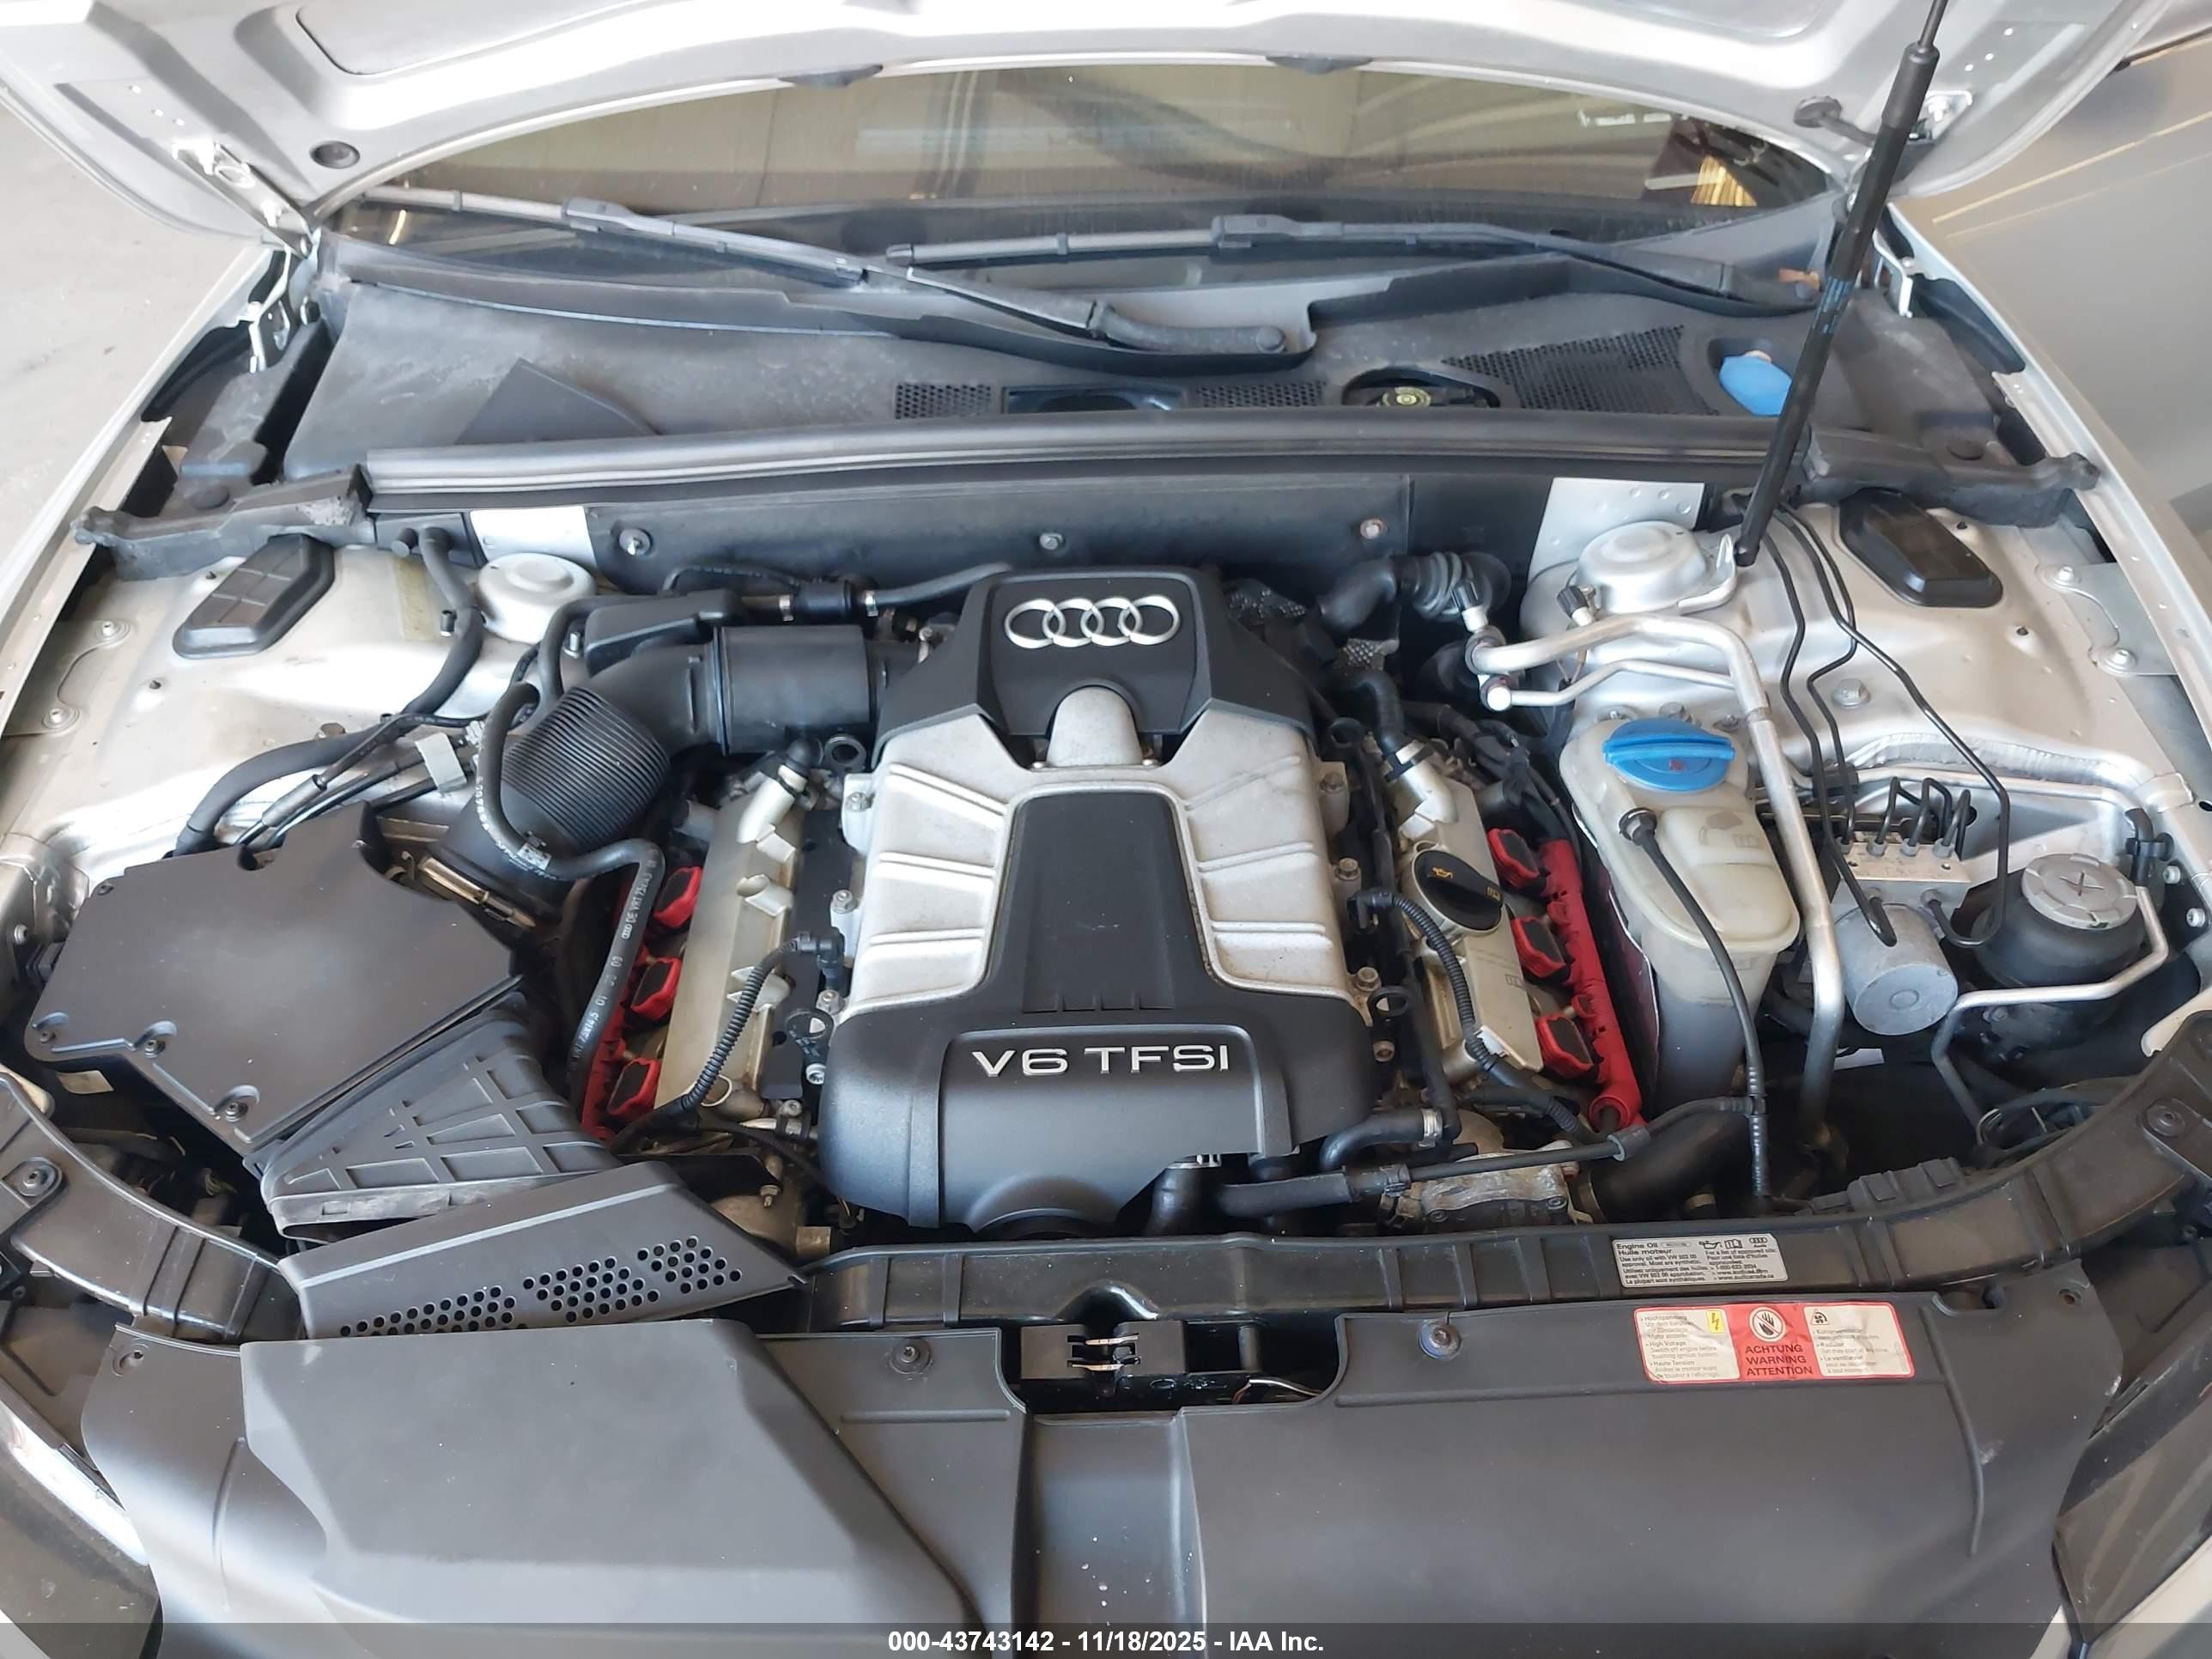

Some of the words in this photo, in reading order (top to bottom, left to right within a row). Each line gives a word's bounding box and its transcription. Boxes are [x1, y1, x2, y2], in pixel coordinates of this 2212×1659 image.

[971, 1048, 1069, 1077] V6
[1084, 1044, 1230, 1074] TFSI
[1616, 1243, 1644, 1251] Engine
[1745, 1343, 1804, 1354] ACHTUNG
[1746, 1355, 1807, 1365] WARNING
[1747, 1366, 1814, 1376] ATTENTION
